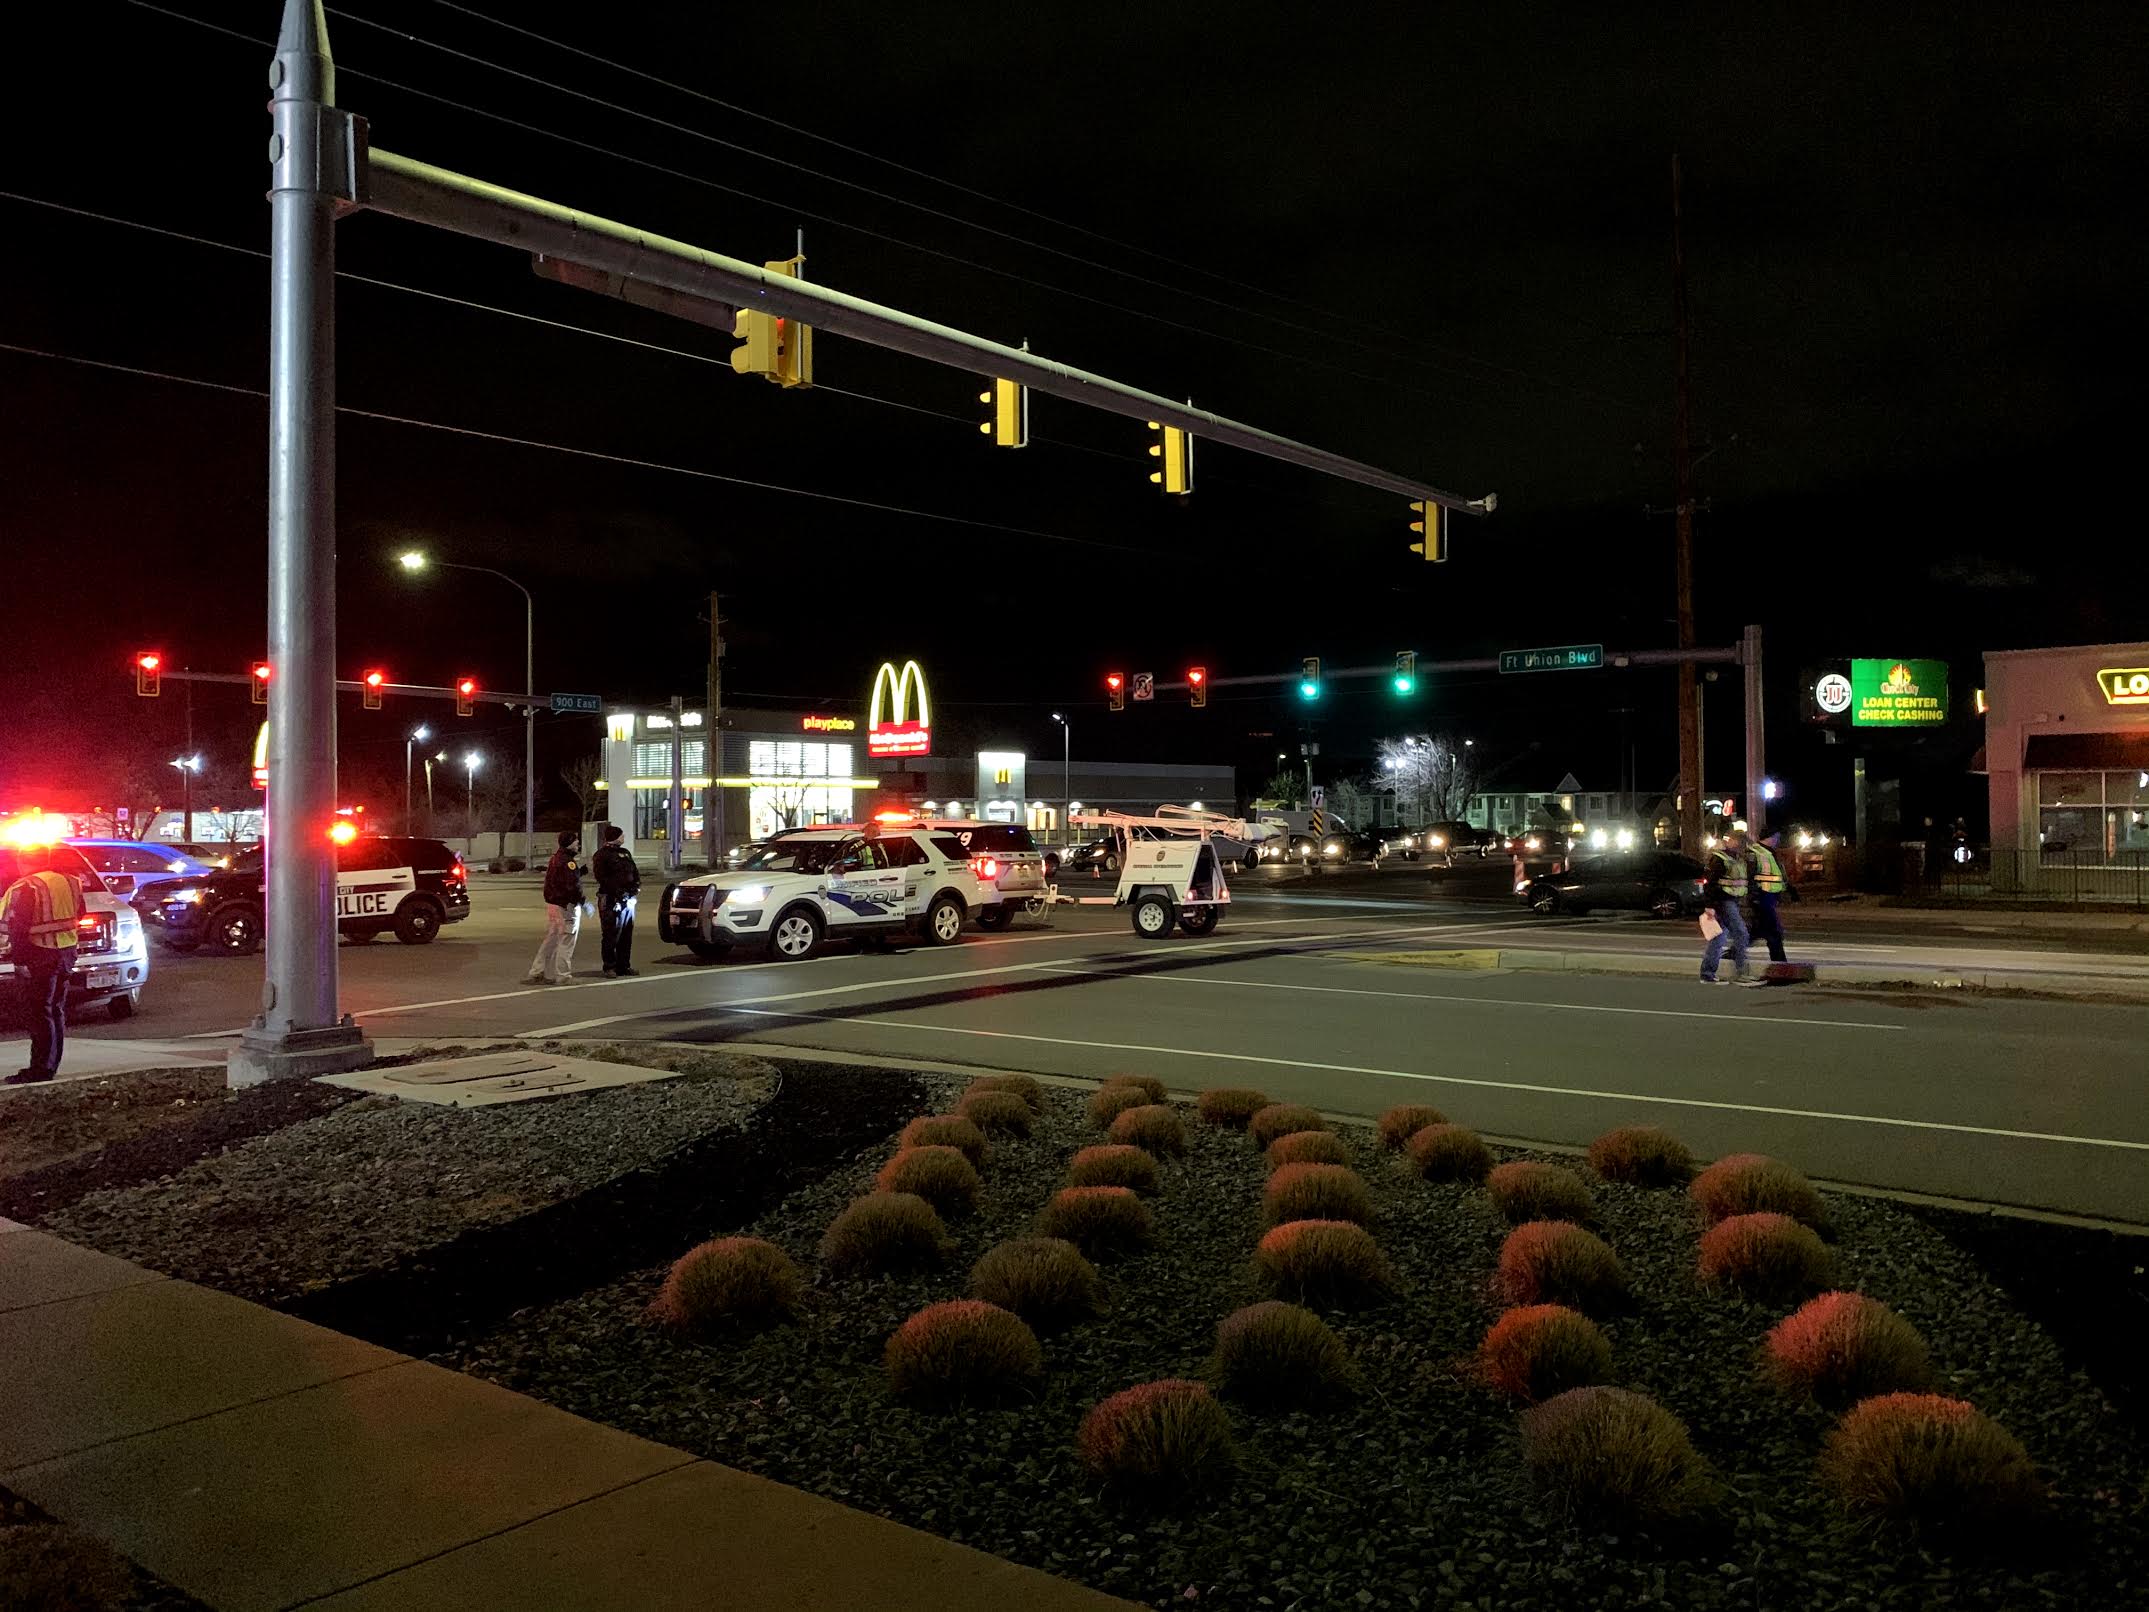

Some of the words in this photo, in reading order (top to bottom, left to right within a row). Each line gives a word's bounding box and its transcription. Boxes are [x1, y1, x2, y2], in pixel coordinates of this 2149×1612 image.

[1506, 655, 1518, 668] Ft
[1524, 654, 1561, 667] Union
[1568, 650, 1596, 664] Blvd
[2114, 674, 2149, 696] LO
[556, 697, 574, 708] 900
[577, 698, 597, 709] East
[1862, 697, 1892, 708] LOAN
[1894, 697, 1938, 708] CENTER
[1858, 709, 1895, 720] CHECK
[1896, 709, 1944, 720] CASHING
[803, 715, 855, 731] playplace
